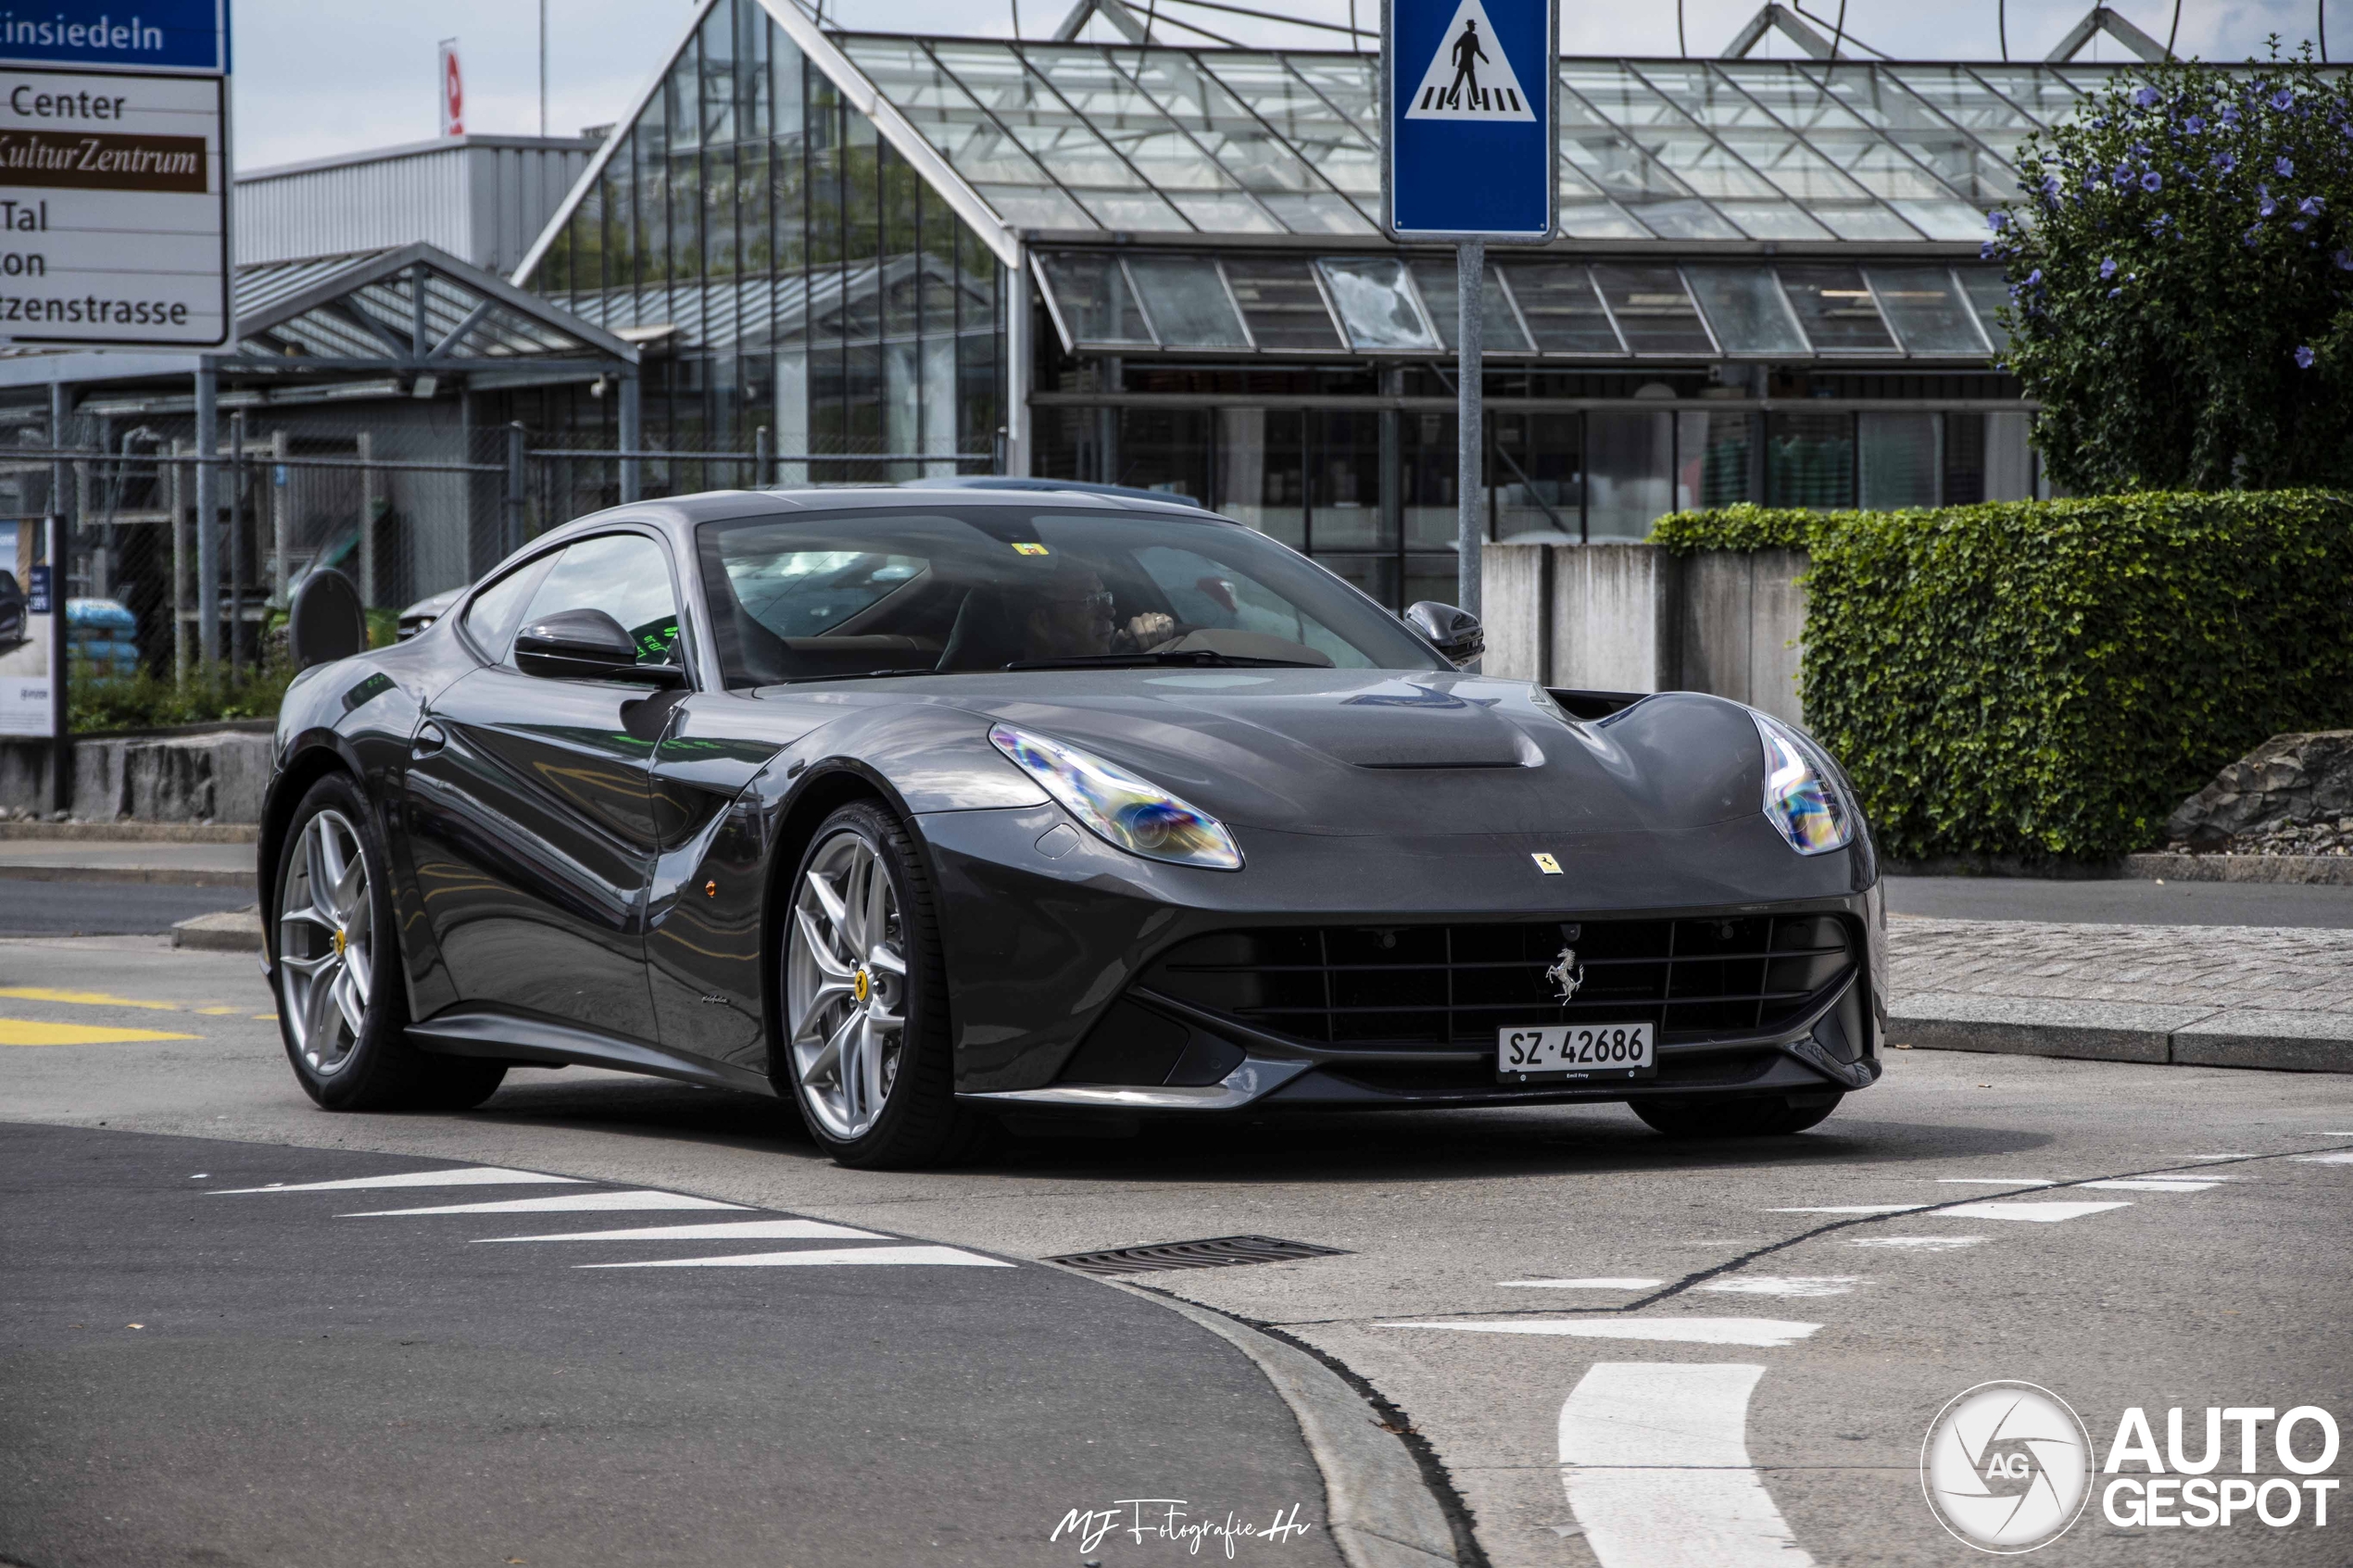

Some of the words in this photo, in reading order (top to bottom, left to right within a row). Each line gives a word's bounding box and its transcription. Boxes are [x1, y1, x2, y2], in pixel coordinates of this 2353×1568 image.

[0, 11, 164, 50] insiedeln
[10, 85, 126, 119] Center
[2, 200, 47, 232] Tal
[0, 251, 45, 276] on
[1509, 1032, 1542, 1065] SZ
[1560, 1027, 1643, 1063] 42686
